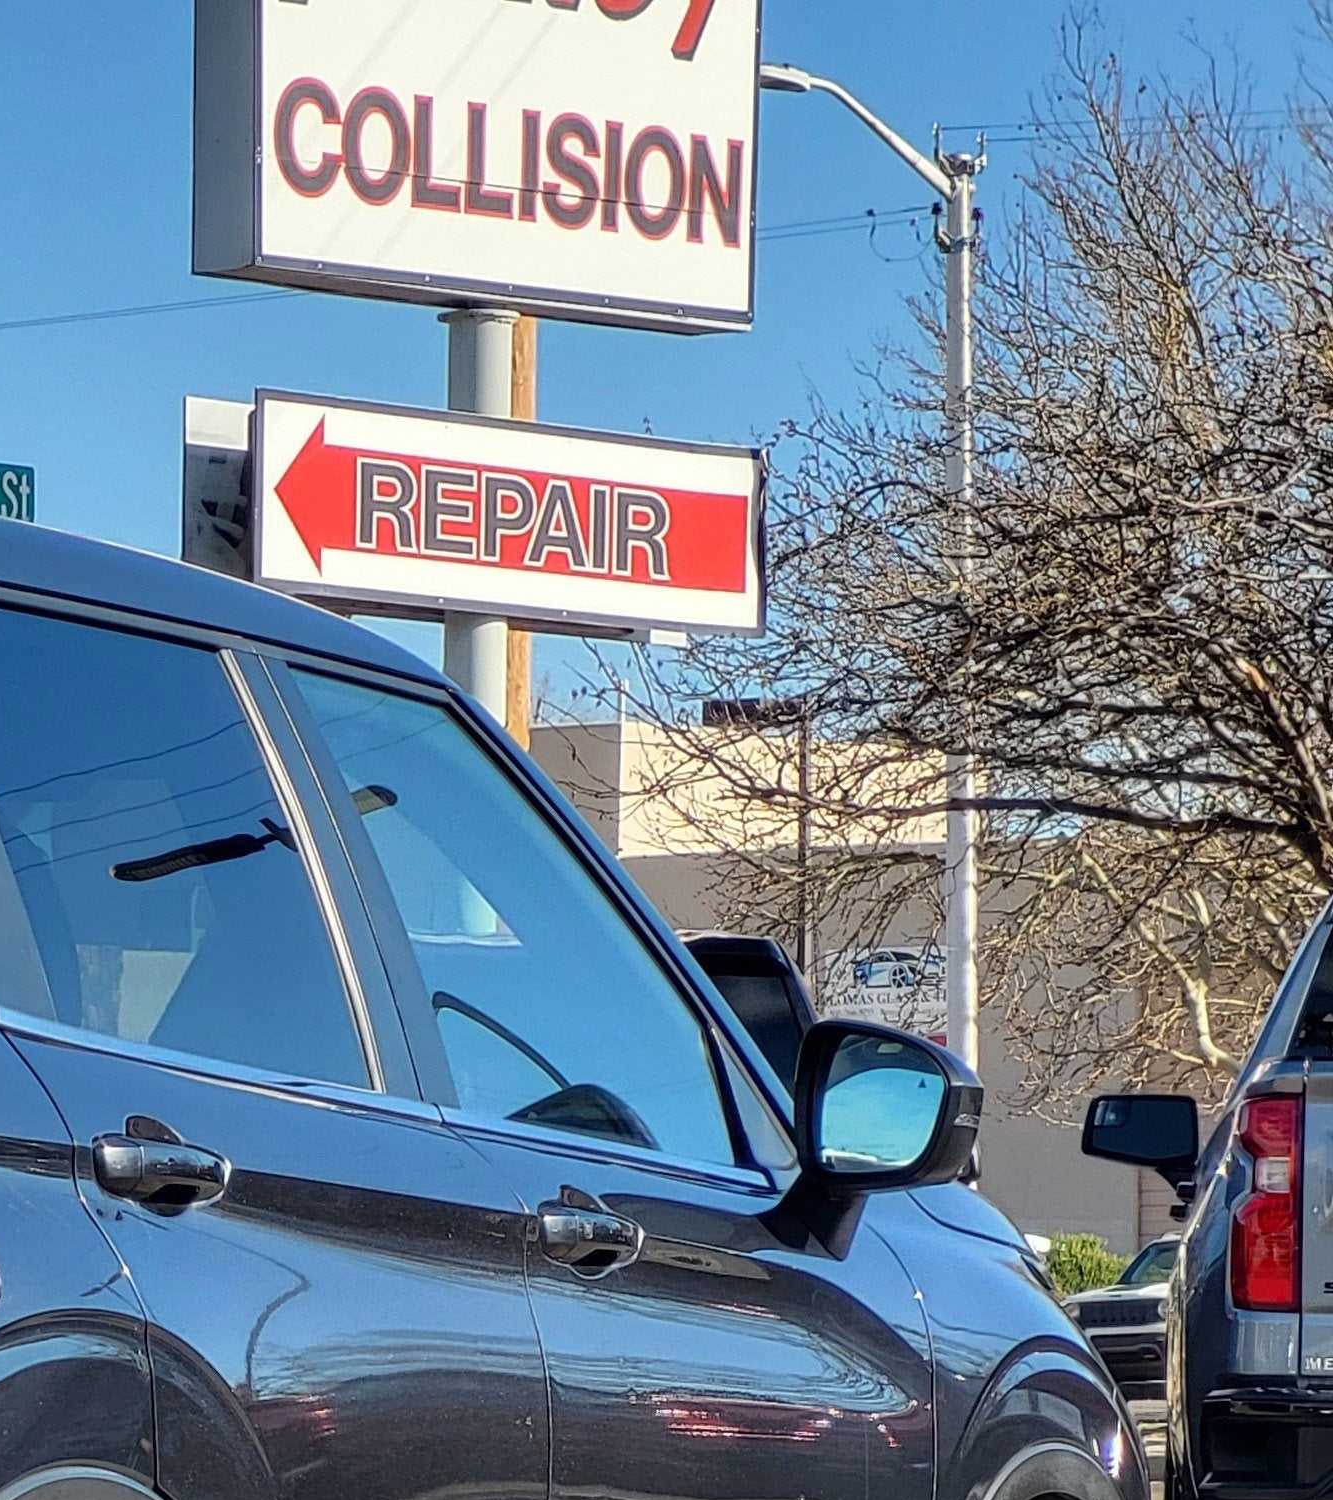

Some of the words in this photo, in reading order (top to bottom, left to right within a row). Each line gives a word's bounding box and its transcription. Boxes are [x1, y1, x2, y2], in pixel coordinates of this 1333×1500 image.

[274, 77, 744, 249] COLLISION
[1, 471, 30, 522] St
[356, 456, 671, 580] REPAIR
